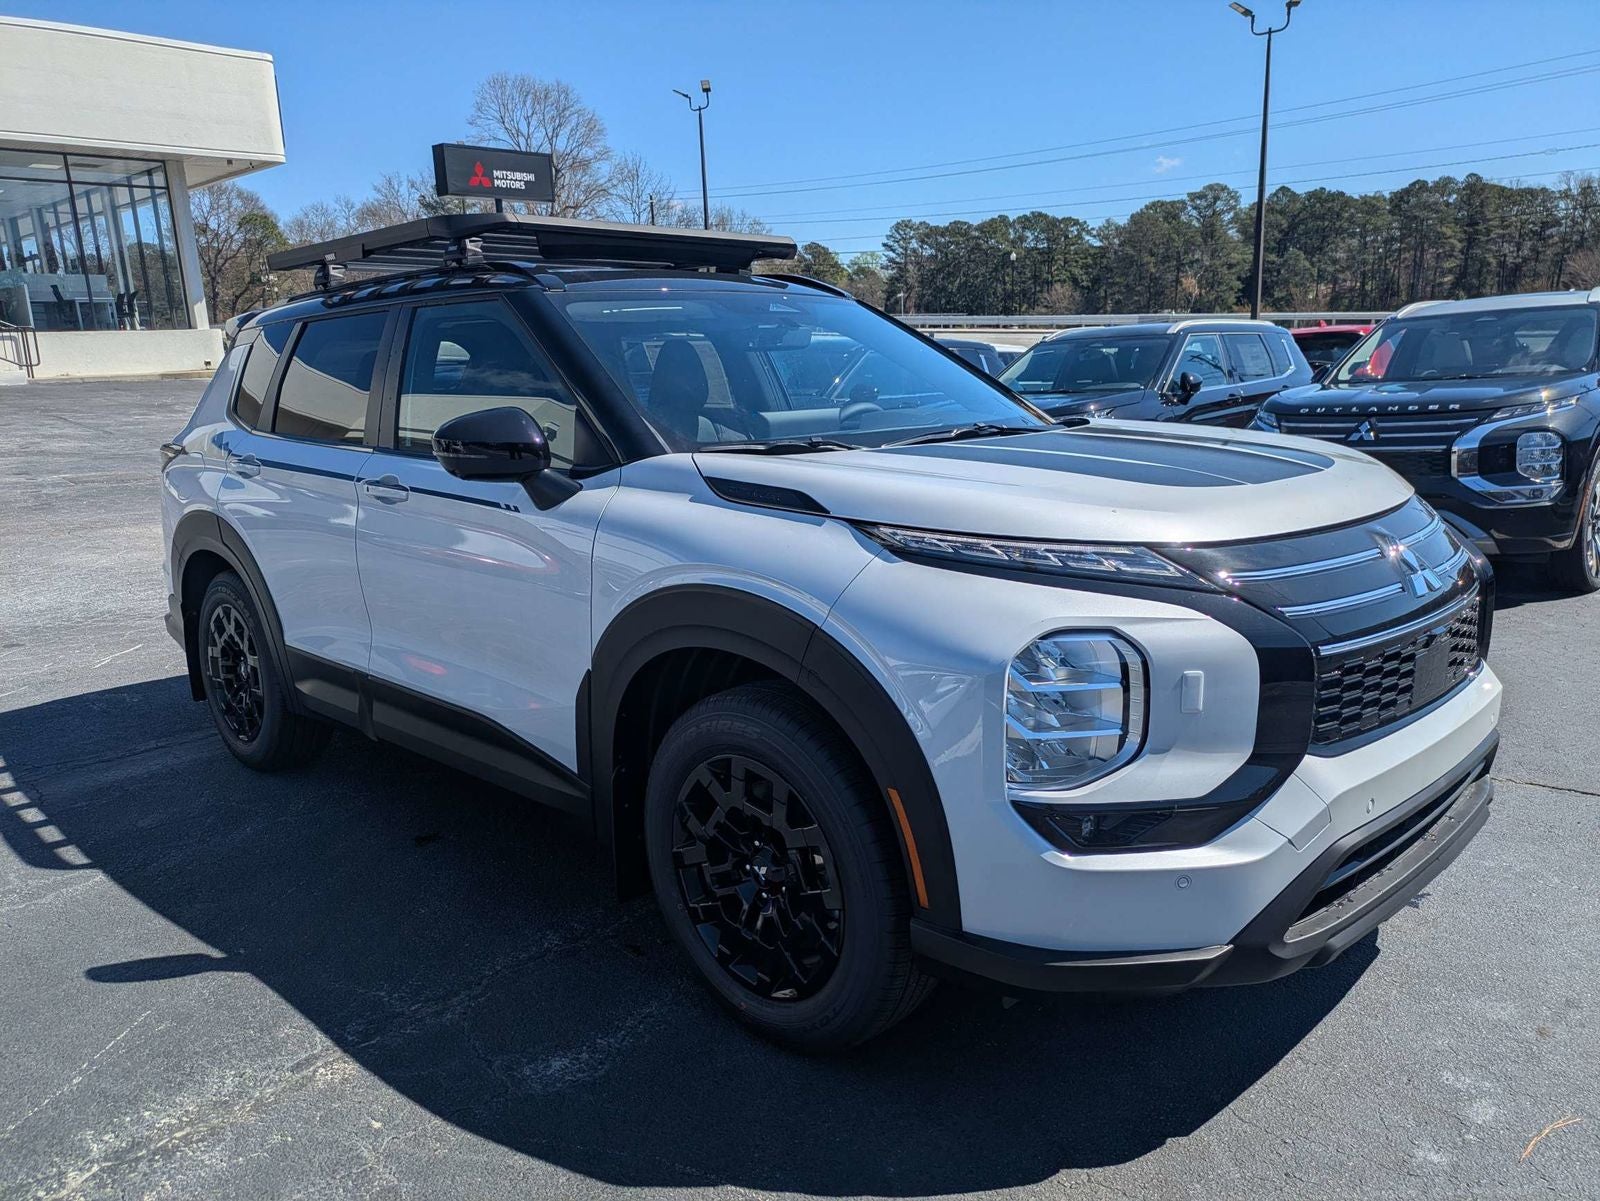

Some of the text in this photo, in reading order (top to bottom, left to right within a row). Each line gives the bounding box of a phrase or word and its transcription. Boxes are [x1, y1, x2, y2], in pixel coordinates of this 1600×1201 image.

[493, 170, 535, 181] MITSUBISHI
[495, 180, 525, 189] MOTORS
[1300, 404, 1461, 413] OUTLANDER
